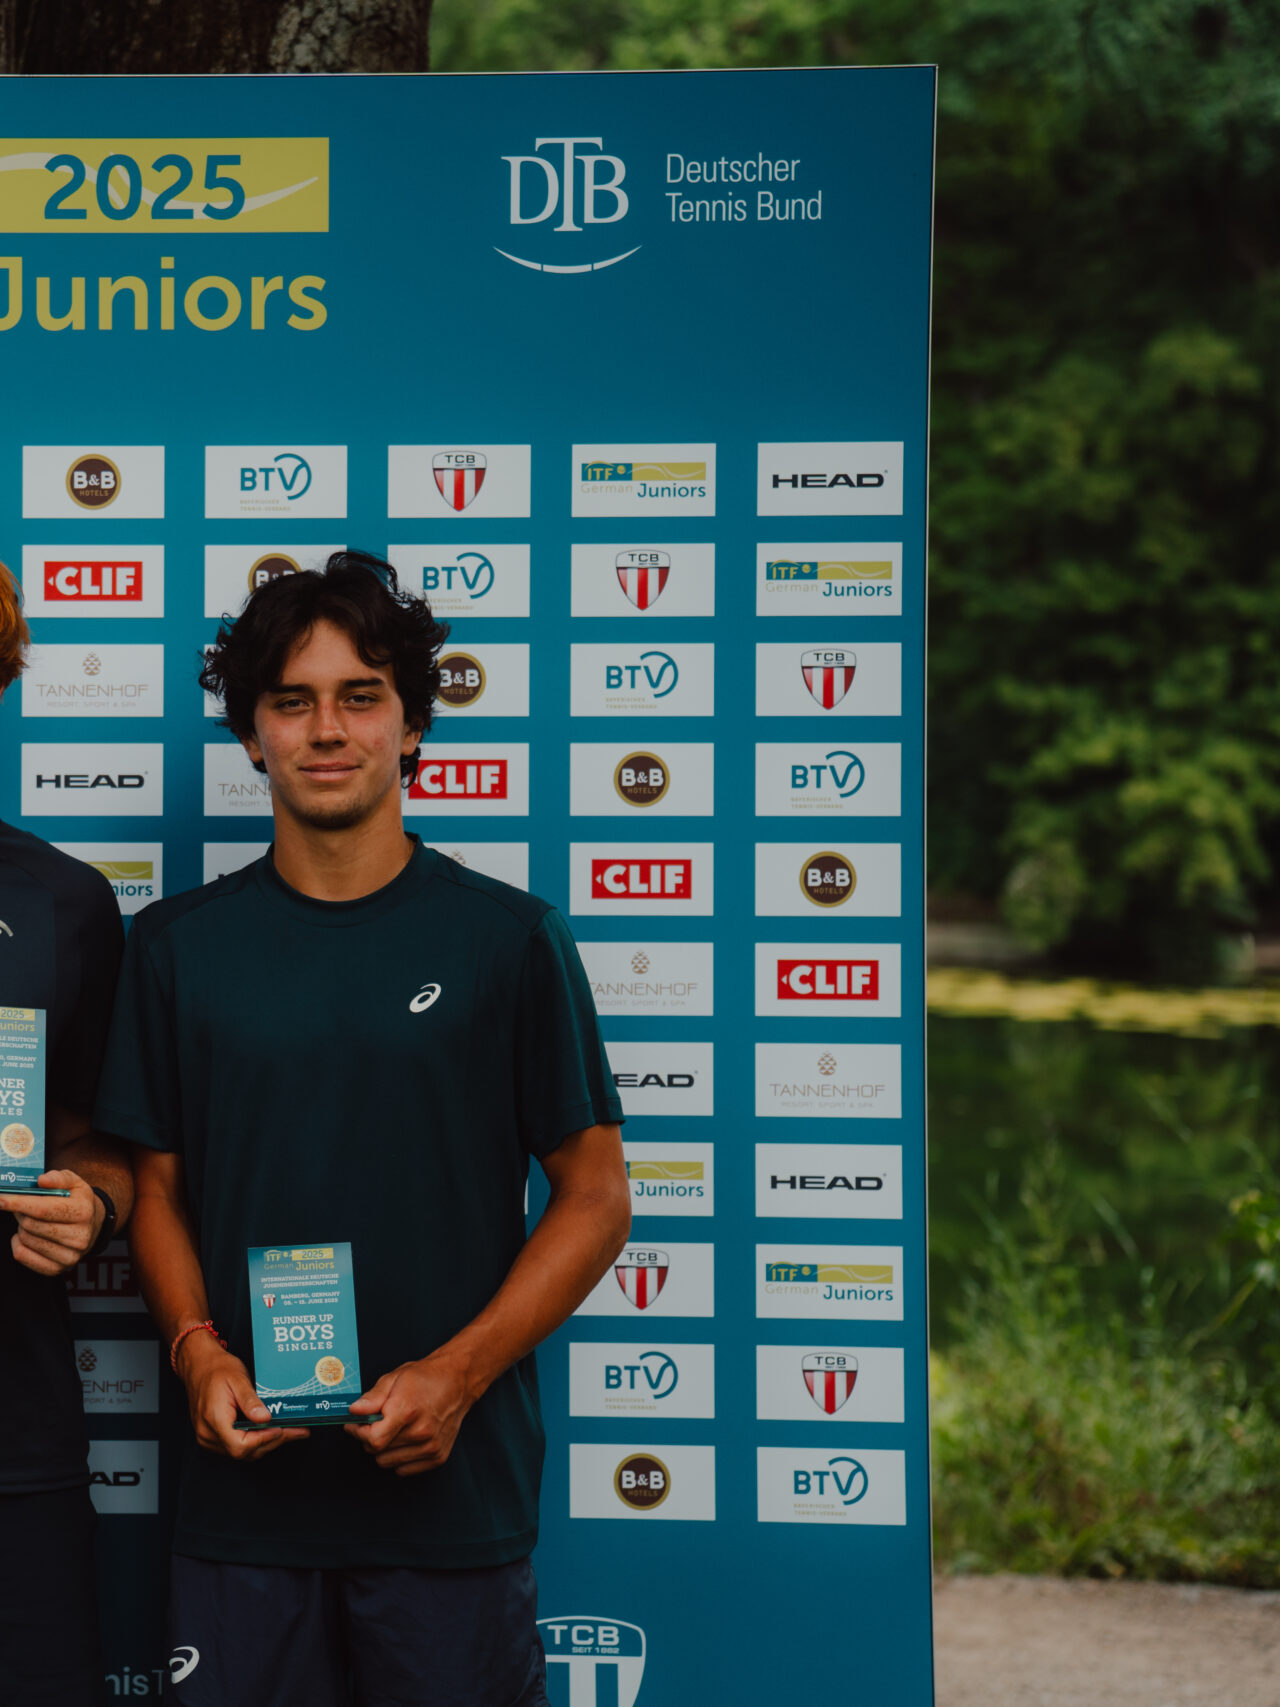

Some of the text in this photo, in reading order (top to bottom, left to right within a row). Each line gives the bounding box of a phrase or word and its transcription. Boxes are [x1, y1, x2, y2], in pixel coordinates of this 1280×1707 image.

[666, 152, 801, 184] Deutscher
[43, 154, 247, 221] 2025
[501, 137, 629, 232] DTB
[665, 190, 822, 223] Tennis Bund
[444, 454, 475, 463] TCB
[73, 470, 115, 489] B&B
[240, 461, 305, 492] BTV
[587, 467, 613, 480] ITF
[772, 474, 884, 487] HEAD
[580, 483, 706, 498] German Juniors
[628, 553, 658, 562] TCB
[55, 566, 134, 595] CLIF
[423, 560, 488, 590] BTV
[772, 566, 798, 579] ITF
[765, 582, 892, 597] German Juniors
[813, 653, 844, 661] TCB
[439, 669, 480, 687] B&B
[606, 659, 672, 690] BTV
[36, 684, 148, 697] TANNENHOF
[36, 775, 144, 788] HEAD
[419, 764, 499, 793] CLIF
[621, 768, 664, 786] B&B
[791, 759, 857, 789] BTV
[603, 864, 683, 893] CLIF
[807, 868, 850, 887] B&B
[112, 881, 153, 897] niors
[789, 965, 870, 994] CLIF
[1, 1009, 25, 1019] 2025
[769, 1084, 885, 1097] TANNENHOF
[635, 1180, 704, 1198] Juniors
[770, 1176, 883, 1190] HEAD
[266, 1251, 325, 1262] ITF 2025
[626, 1252, 657, 1261] TCB
[296, 1261, 335, 1271] Juniors
[66, 1262, 130, 1290] LIF
[772, 1268, 798, 1281] ITF
[765, 1285, 893, 1301] German Juniors
[272, 1313, 334, 1325] RUNNER UP
[273, 1323, 334, 1343] BOYS
[277, 1341, 333, 1352] SINGLES
[814, 1356, 846, 1365] TCB
[605, 1359, 671, 1391] BTV
[82, 1379, 145, 1394] ENHOF
[91, 1472, 140, 1487] AD
[621, 1470, 664, 1489] B&B
[793, 1464, 861, 1496] BTV
[547, 1625, 620, 1646] TCB
